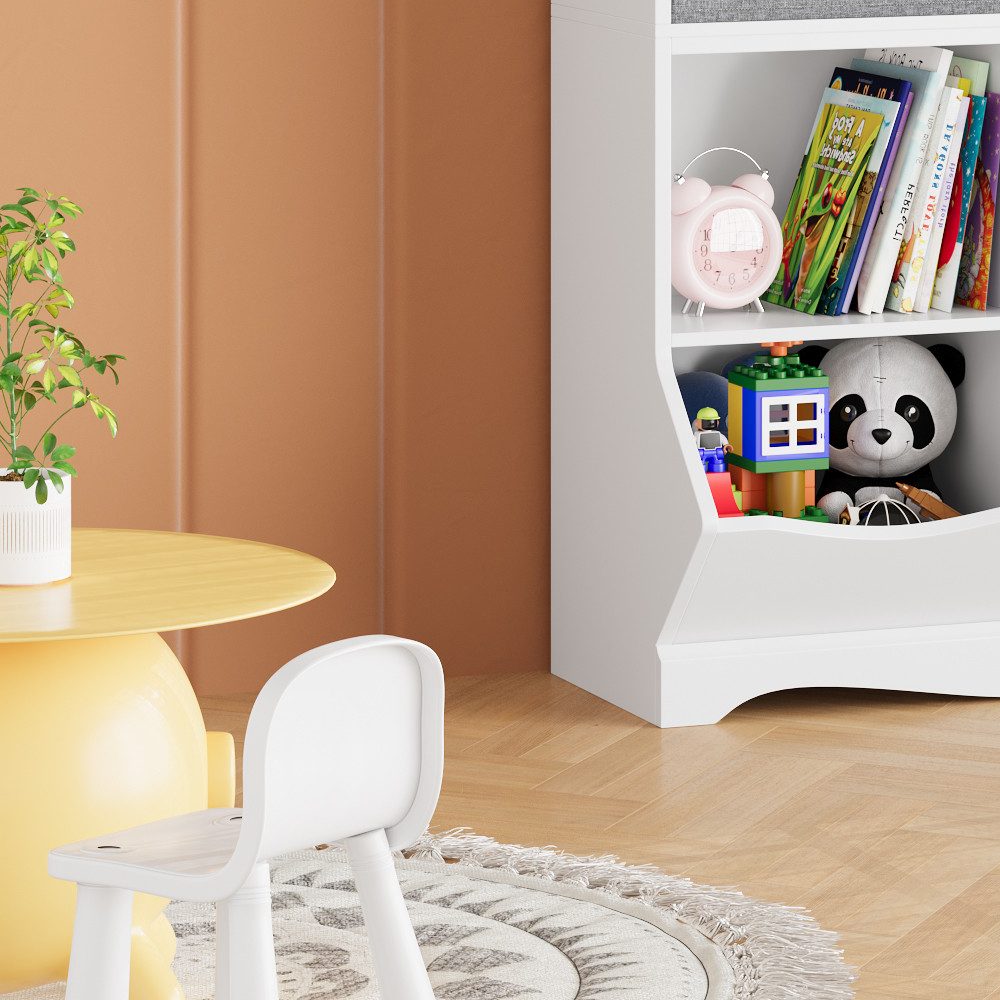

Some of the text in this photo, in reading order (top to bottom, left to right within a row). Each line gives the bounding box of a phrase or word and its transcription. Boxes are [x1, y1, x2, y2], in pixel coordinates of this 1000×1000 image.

[700, 244, 708, 257] 9
[704, 259, 712, 272] 8
[751, 256, 757, 268] 4
[714, 270, 722, 282] 7
[729, 272, 736, 286] 6
[742, 268, 750, 280] 5
